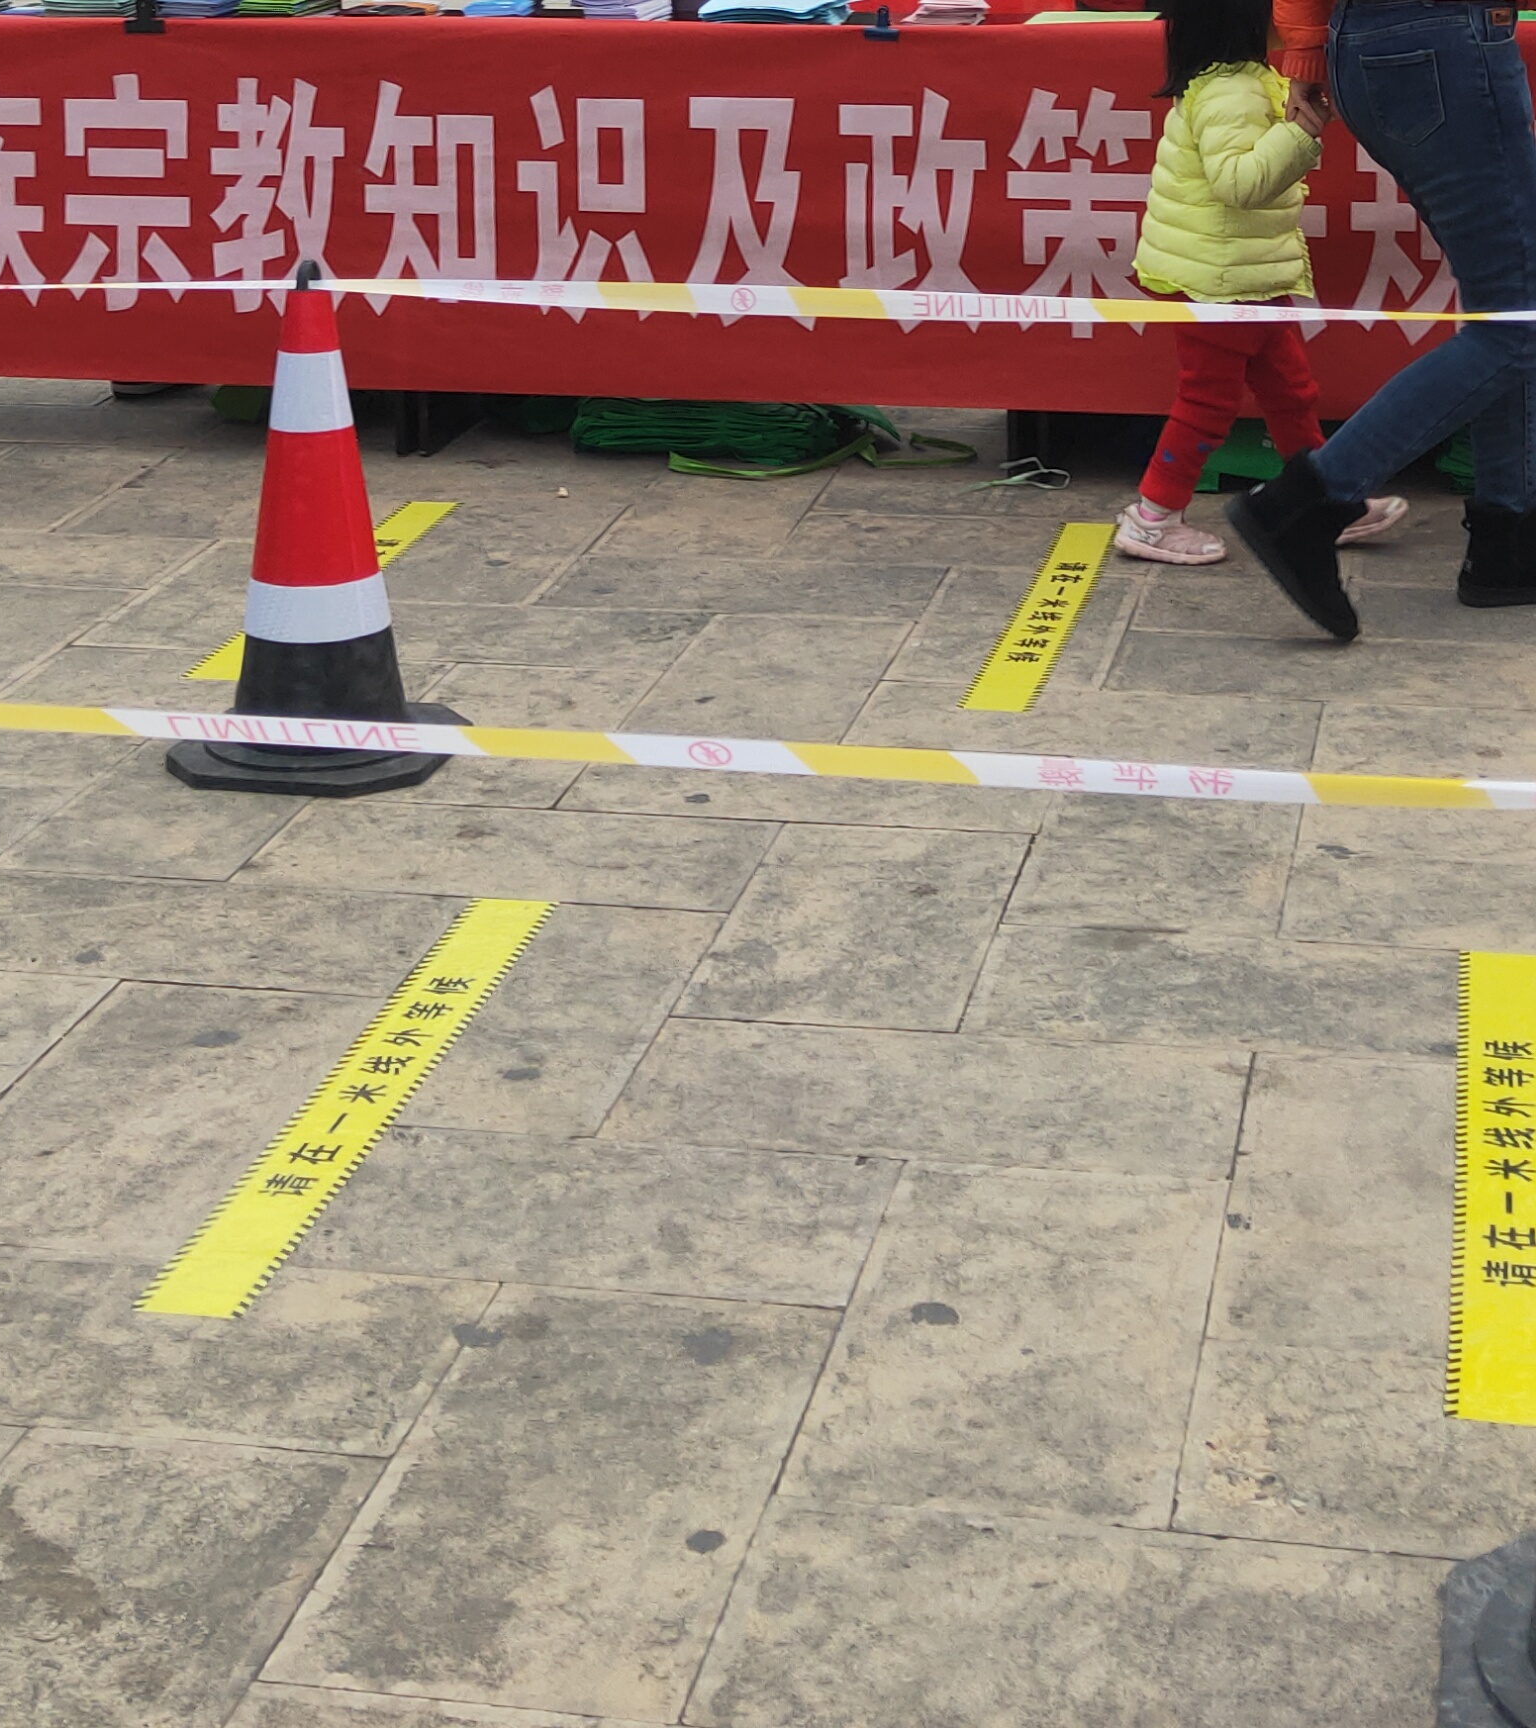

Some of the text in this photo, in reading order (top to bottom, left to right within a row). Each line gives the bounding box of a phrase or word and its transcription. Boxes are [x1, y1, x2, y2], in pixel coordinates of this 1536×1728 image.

[257, 975, 478, 1198] 请在一米线外等候
